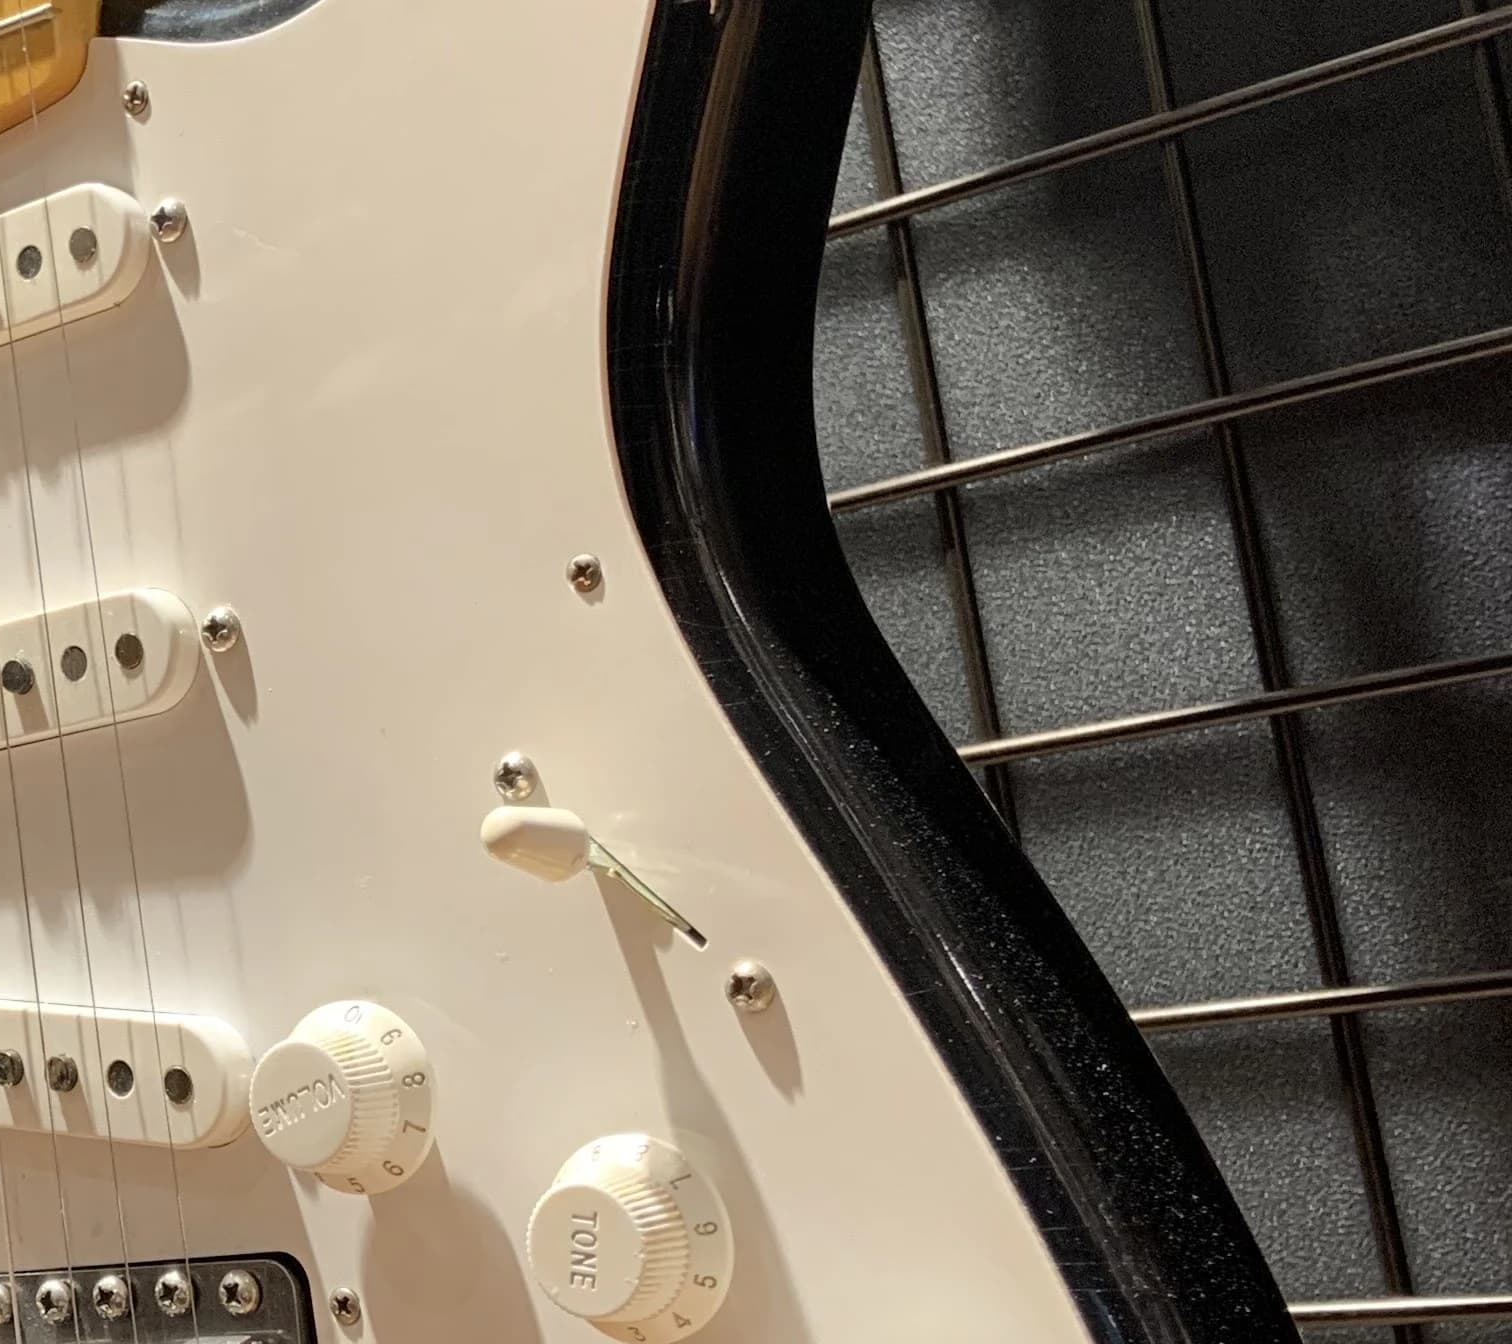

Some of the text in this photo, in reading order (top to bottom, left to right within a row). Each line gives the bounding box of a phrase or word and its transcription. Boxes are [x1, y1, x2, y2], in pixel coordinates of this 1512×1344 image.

[401, 1071, 426, 1089] 8
[257, 1073, 346, 1138] VOLUME
[402, 1119, 427, 1134] 7
[382, 1159, 405, 1178] 6
[347, 1176, 367, 1194] 5
[694, 1221, 719, 1237] 6
[569, 1210, 600, 1293] TONE
[693, 1273, 718, 1290] 5
[672, 1311, 693, 1329] 4
[626, 1325, 647, 1343] 3
